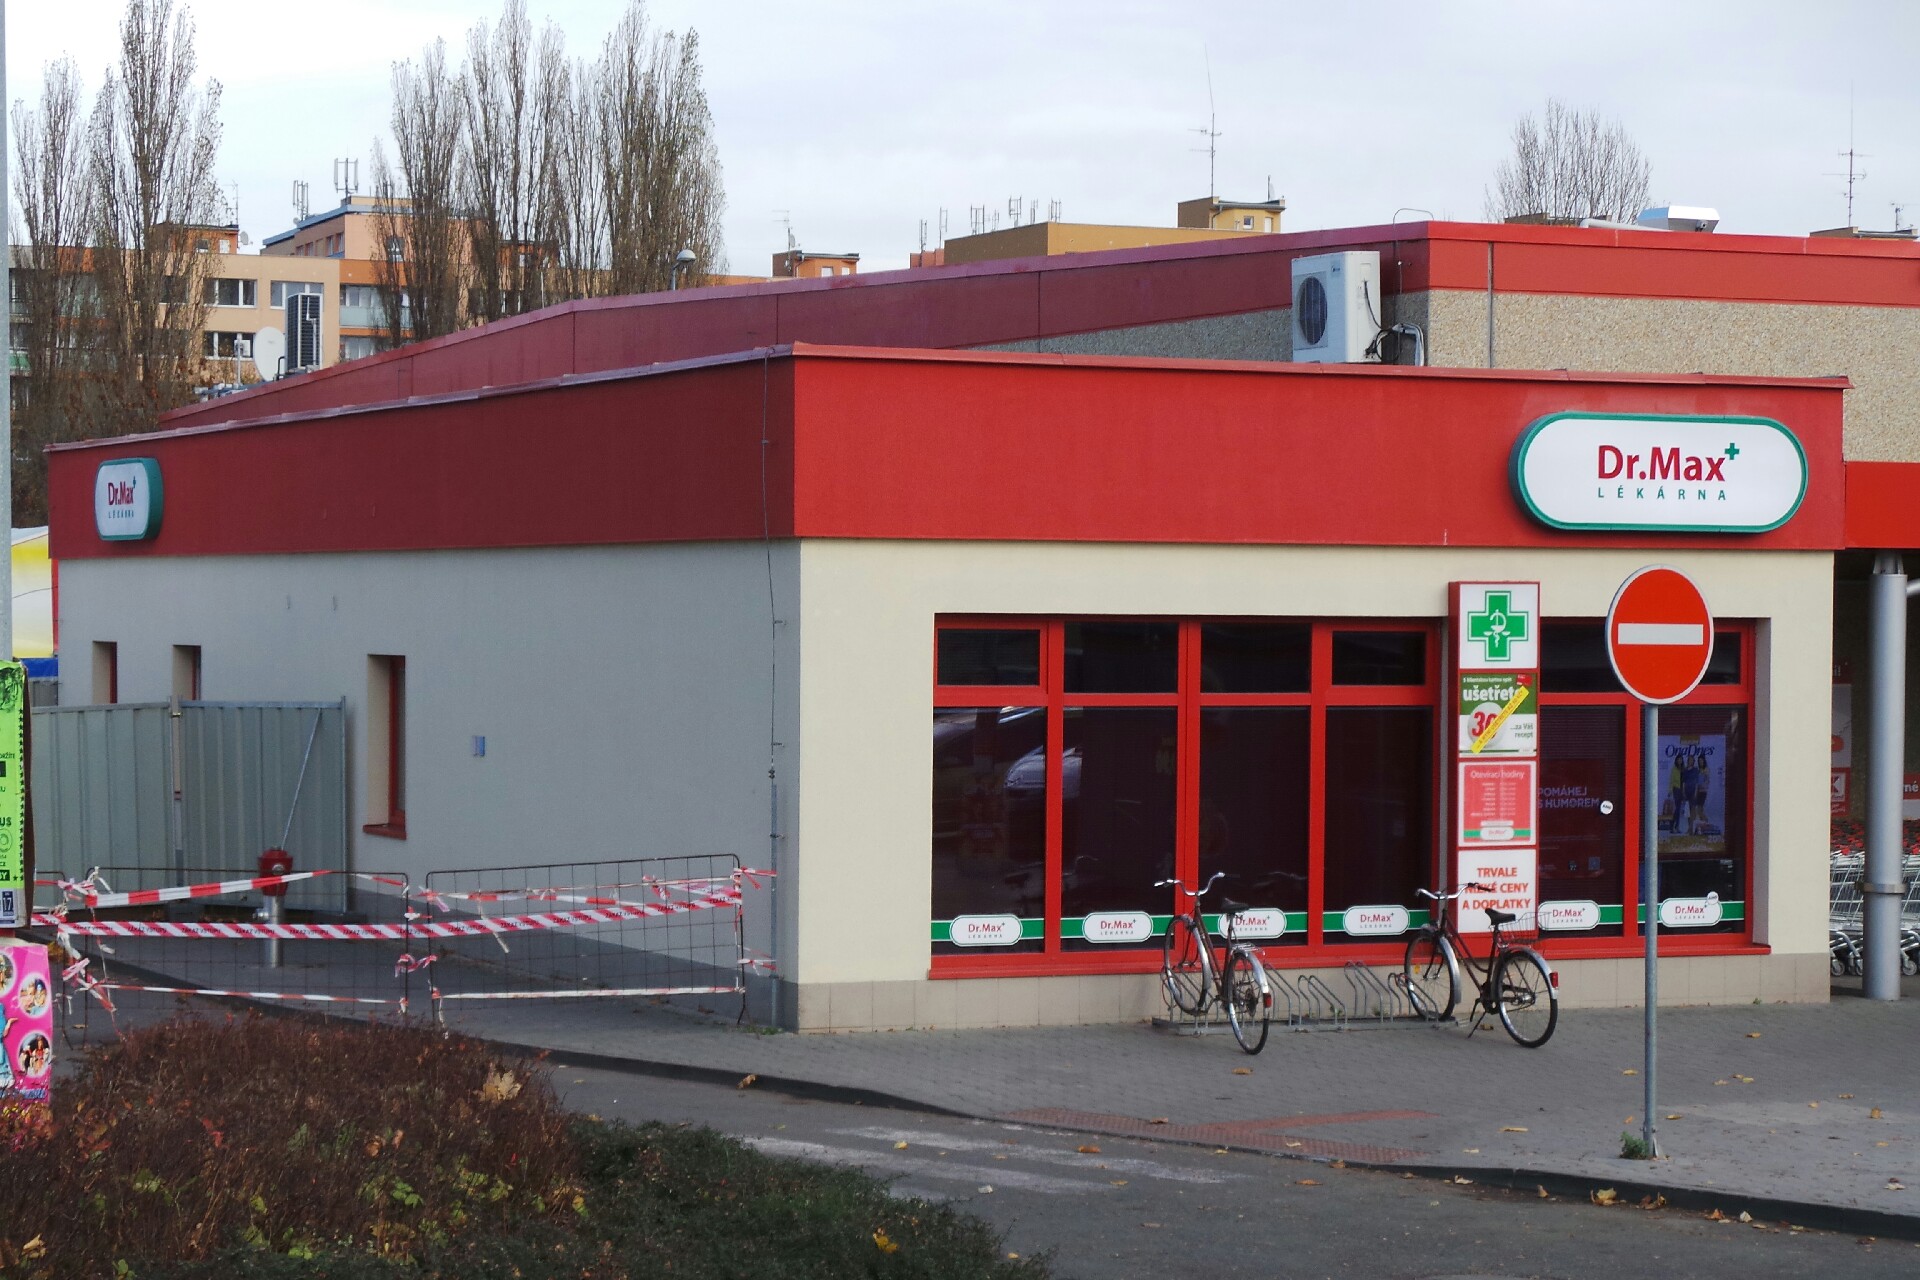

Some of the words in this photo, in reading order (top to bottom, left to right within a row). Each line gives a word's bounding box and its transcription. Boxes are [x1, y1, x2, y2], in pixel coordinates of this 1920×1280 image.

[1598, 486, 1726, 500] LÉKÁRNA
[1501, 770, 1524, 779] hodiny
[1538, 785, 1587, 796] POMÁHEJ
[1546, 798, 1600, 808] HUMOREM
[1477, 867, 1517, 877] TRVALE
[1500, 883, 1528, 893] CENY
[1463, 900, 1469, 910] A
[1473, 899, 1530, 910] DOPLATKY
